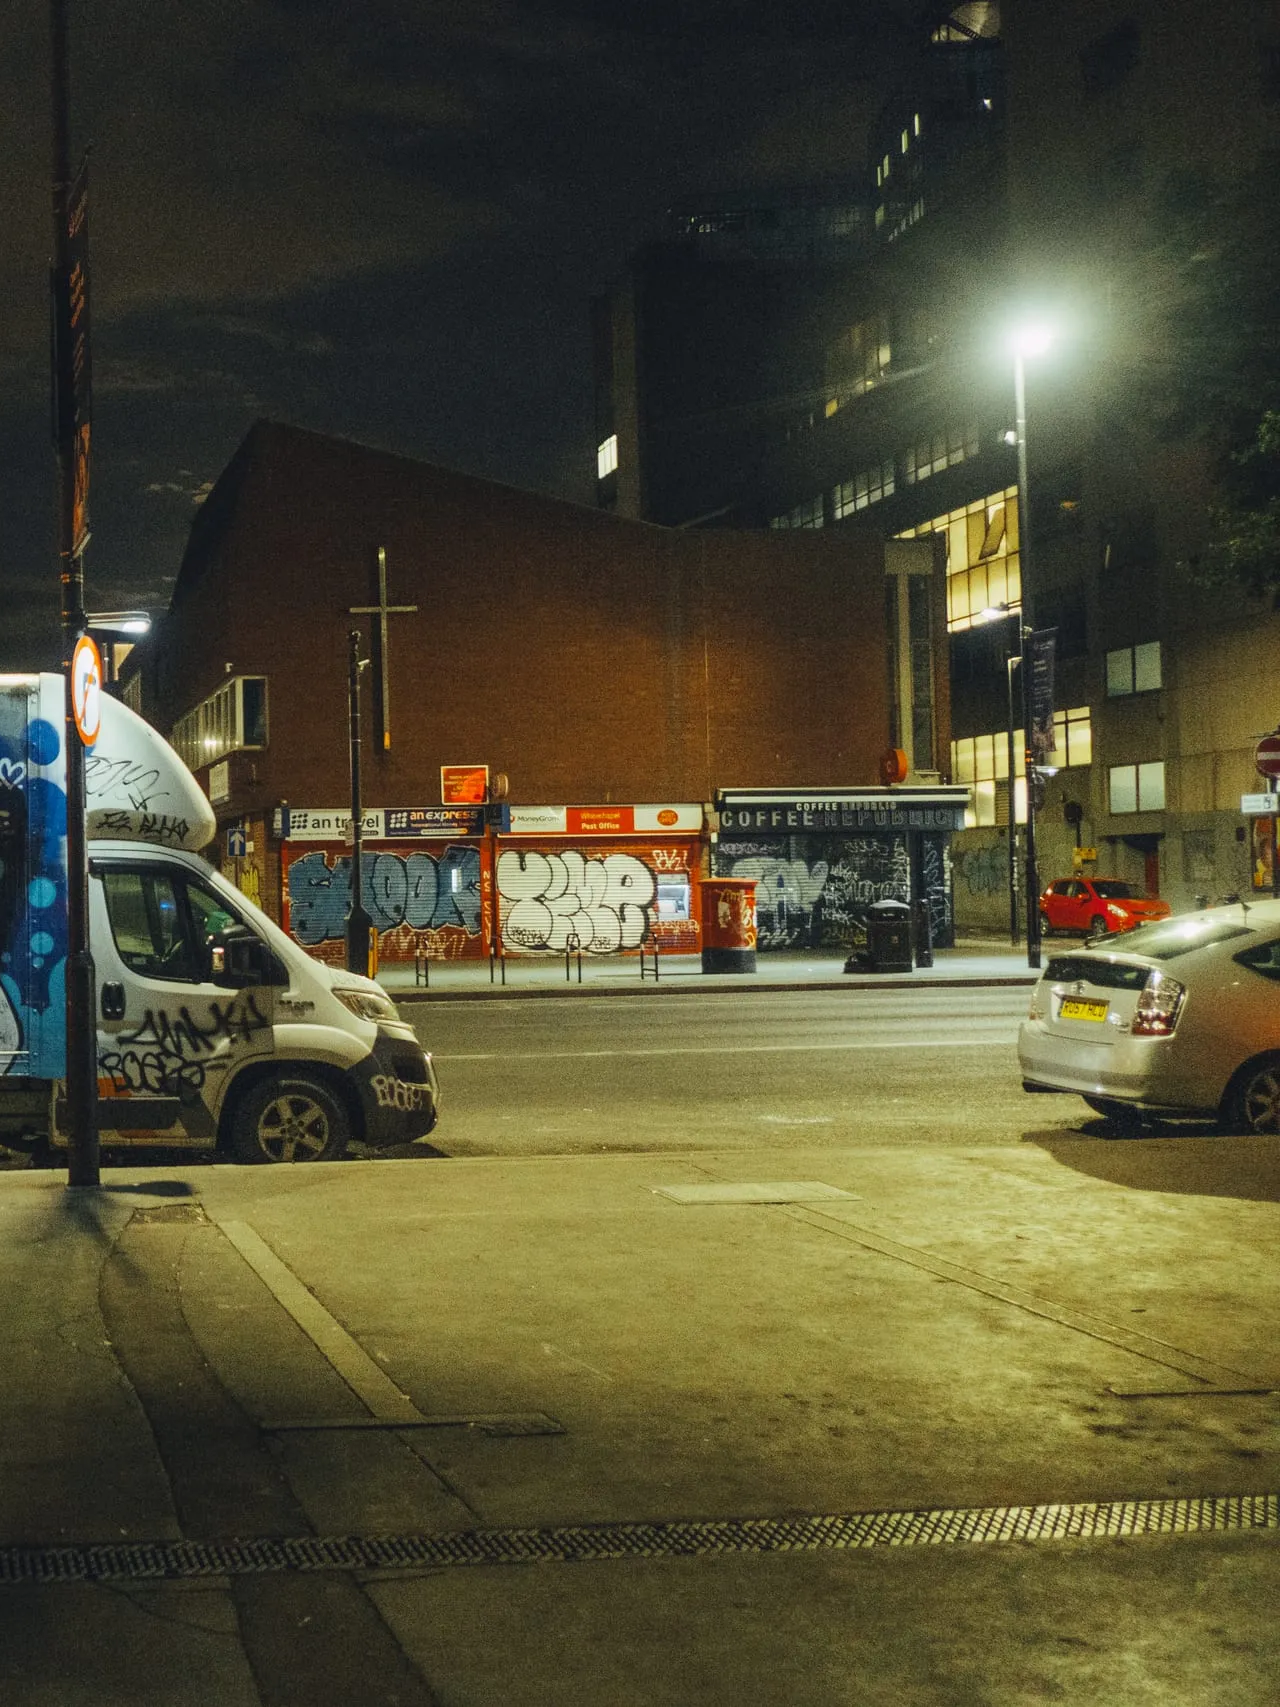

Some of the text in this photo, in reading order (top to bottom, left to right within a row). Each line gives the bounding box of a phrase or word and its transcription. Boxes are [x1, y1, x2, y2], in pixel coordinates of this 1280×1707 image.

[796, 802, 838, 811] COFFEE
[425, 810, 478, 822] express
[721, 809, 955, 827] COFFEE REPUBLIC
[311, 817, 331, 829] an
[581, 822, 620, 830] Post Office
